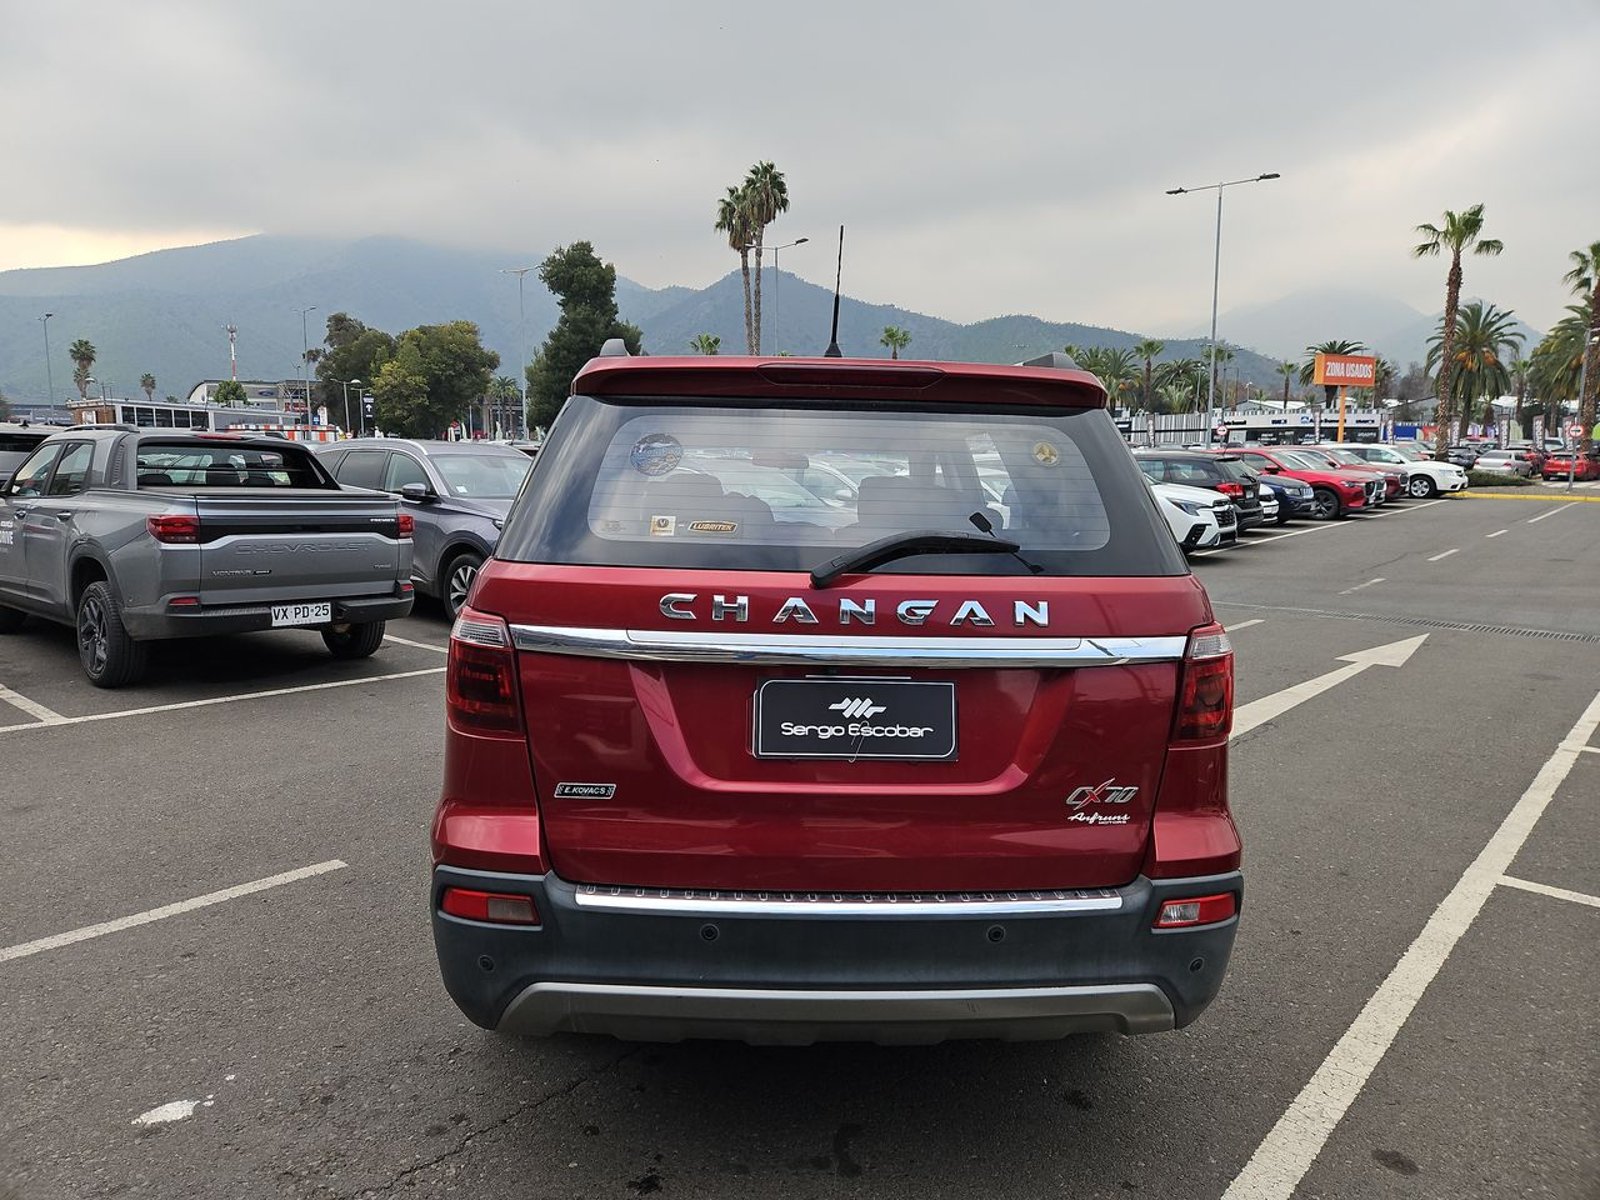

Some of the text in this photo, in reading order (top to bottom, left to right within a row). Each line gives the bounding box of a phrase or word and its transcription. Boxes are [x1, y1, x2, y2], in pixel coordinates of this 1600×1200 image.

[1326, 362, 1372, 378] ZONA USADOS
[692, 522, 736, 531] LUBRITEK
[235, 542, 374, 555] CHEVROLET
[659, 593, 1049, 627] CHANGAN
[781, 722, 934, 739] Sergio Escobar
[1066, 777, 1139, 810] CX70
